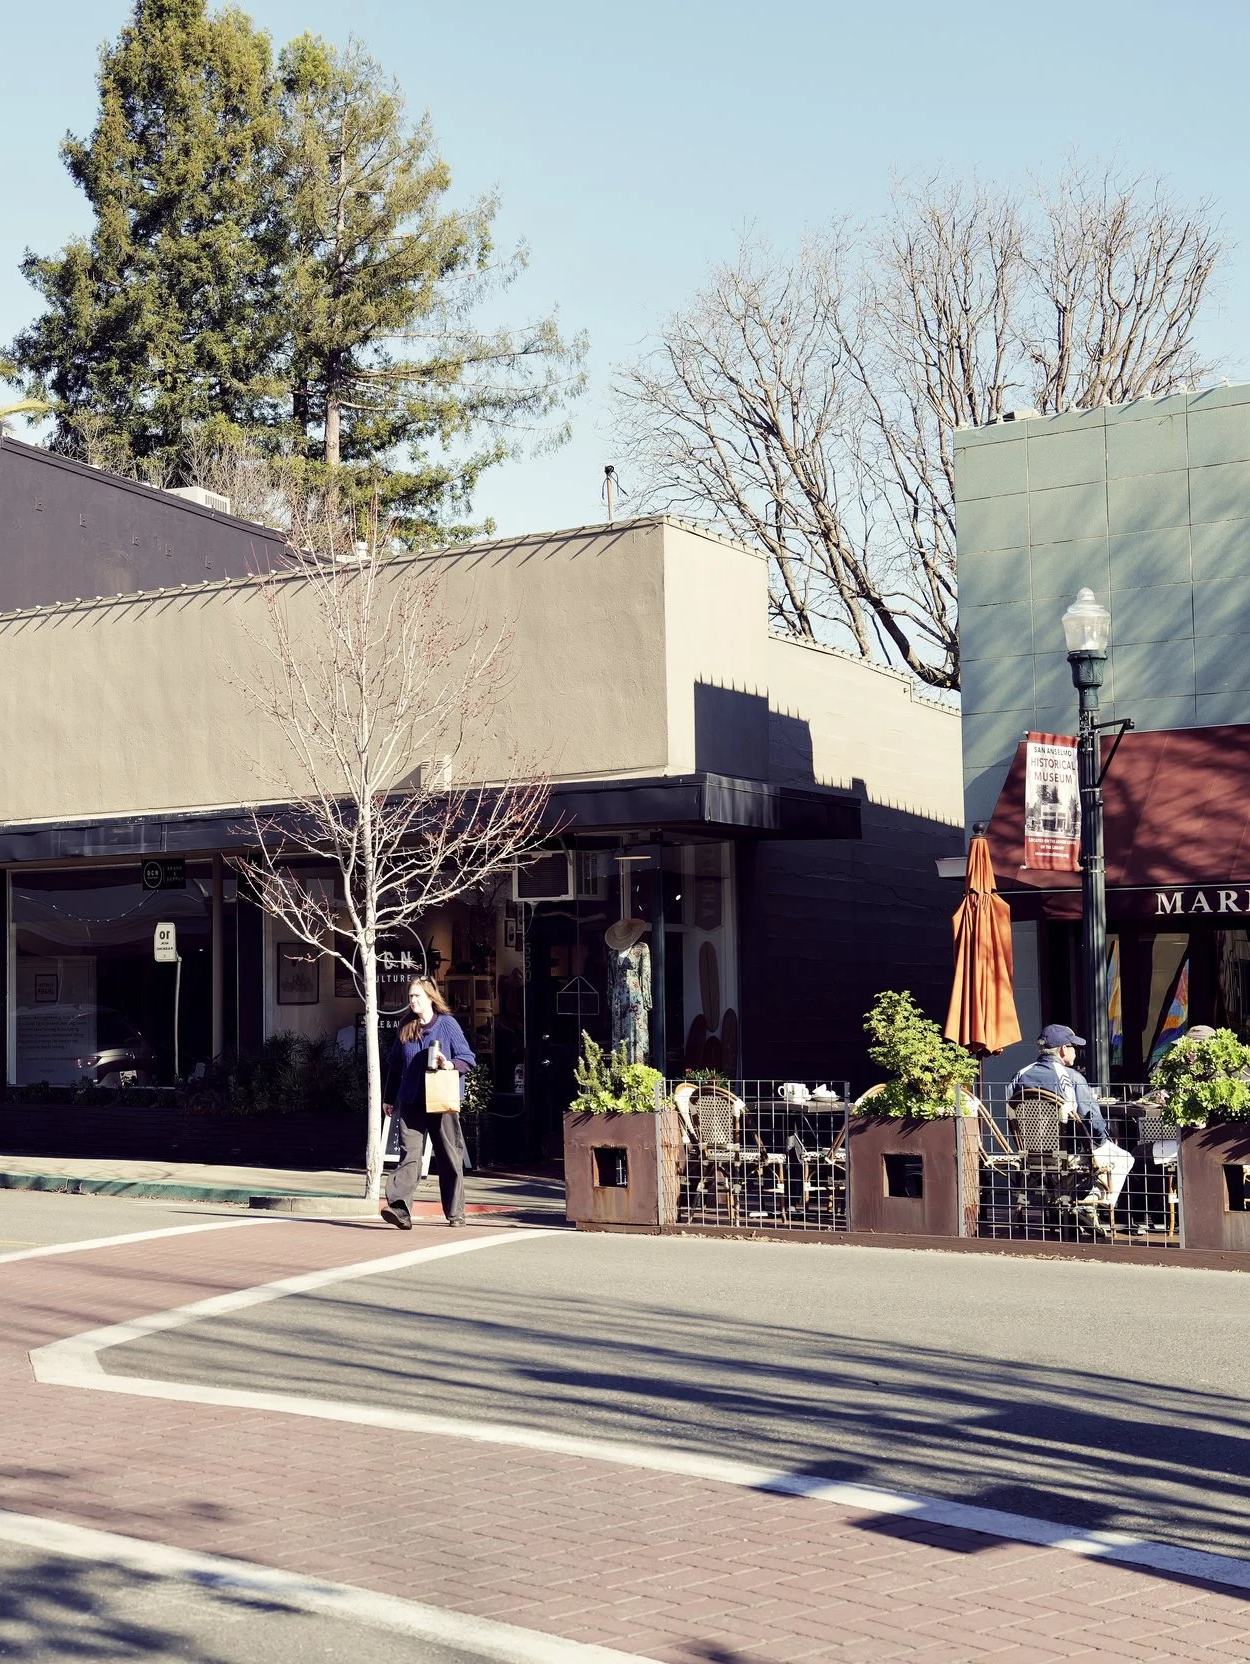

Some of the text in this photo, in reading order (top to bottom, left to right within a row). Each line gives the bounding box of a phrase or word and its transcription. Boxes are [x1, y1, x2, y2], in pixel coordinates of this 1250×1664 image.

[1033, 746, 1072, 757] SAN ANSELMO
[1030, 757, 1076, 771] HISTORICAL
[1034, 771, 1073, 784] MUSEUM
[1155, 889, 1250, 915] MAR
